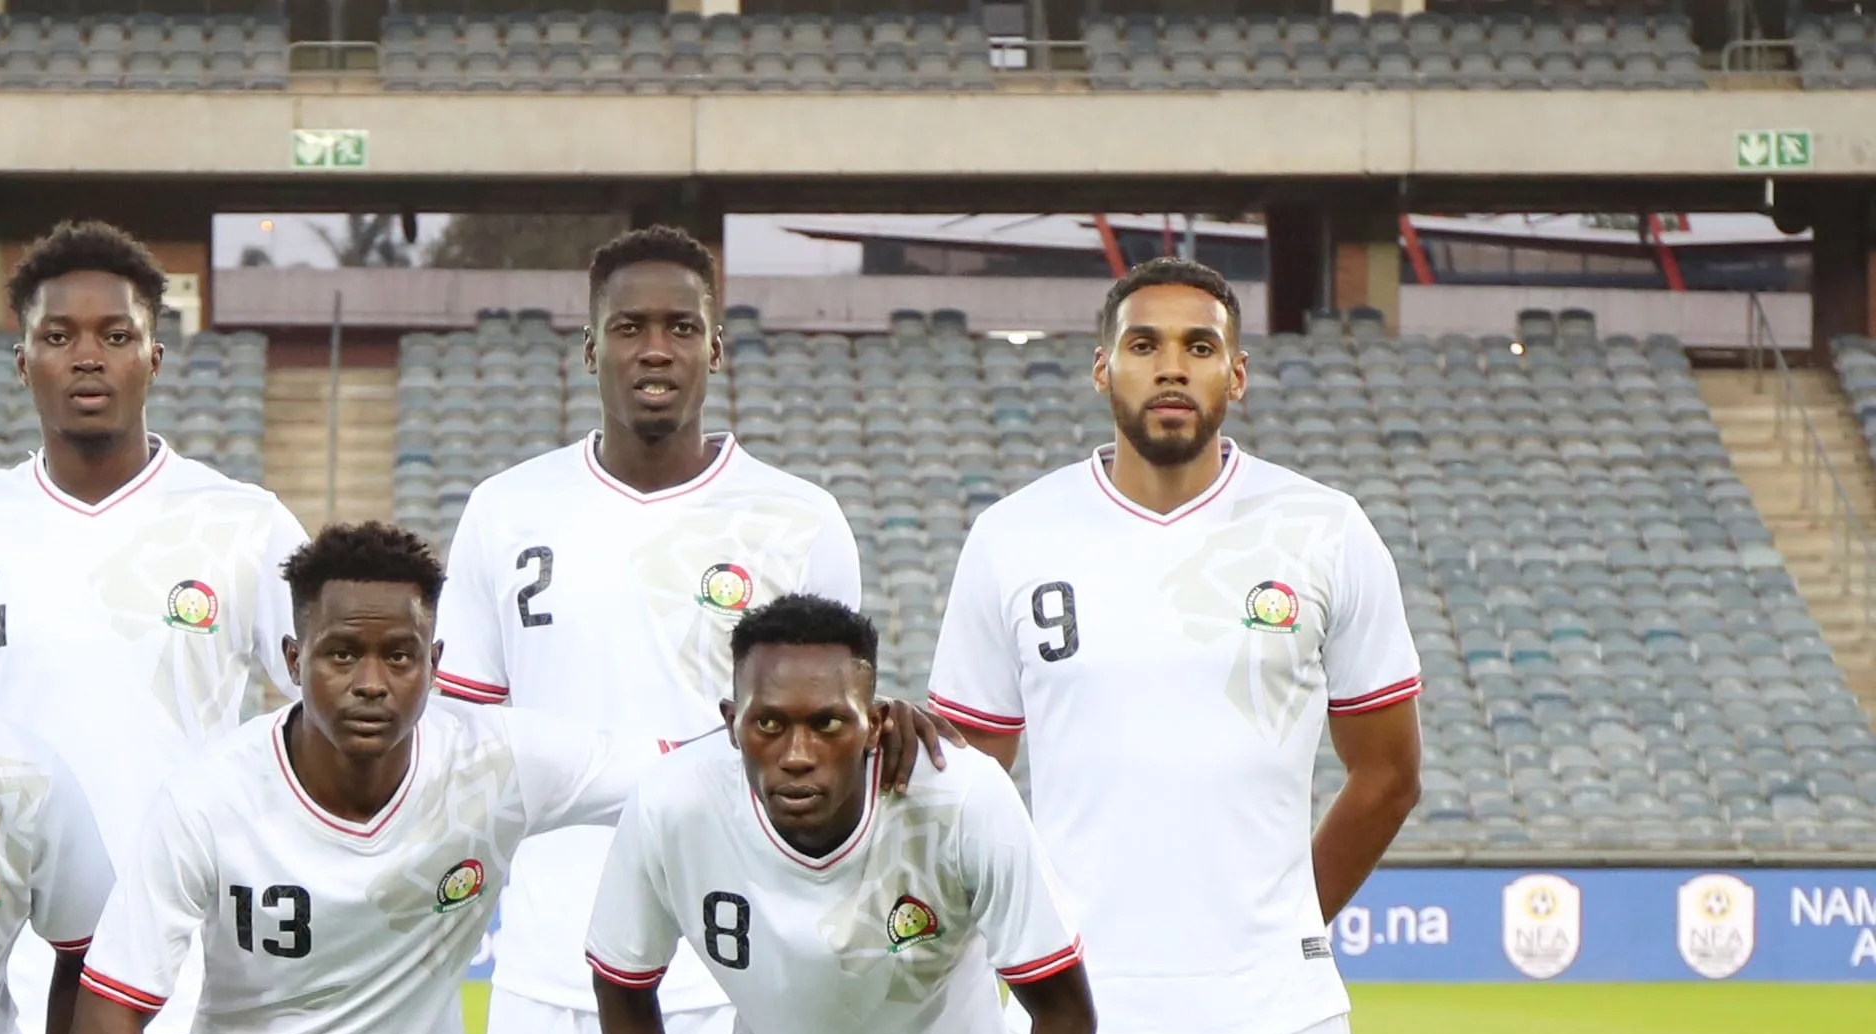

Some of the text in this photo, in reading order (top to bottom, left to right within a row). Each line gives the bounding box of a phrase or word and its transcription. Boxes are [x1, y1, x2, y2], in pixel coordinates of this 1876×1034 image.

[515, 545, 554, 628] 2
[1031, 581, 1080, 662] 9
[229, 884, 312, 958] 13
[702, 891, 751, 969] 8
